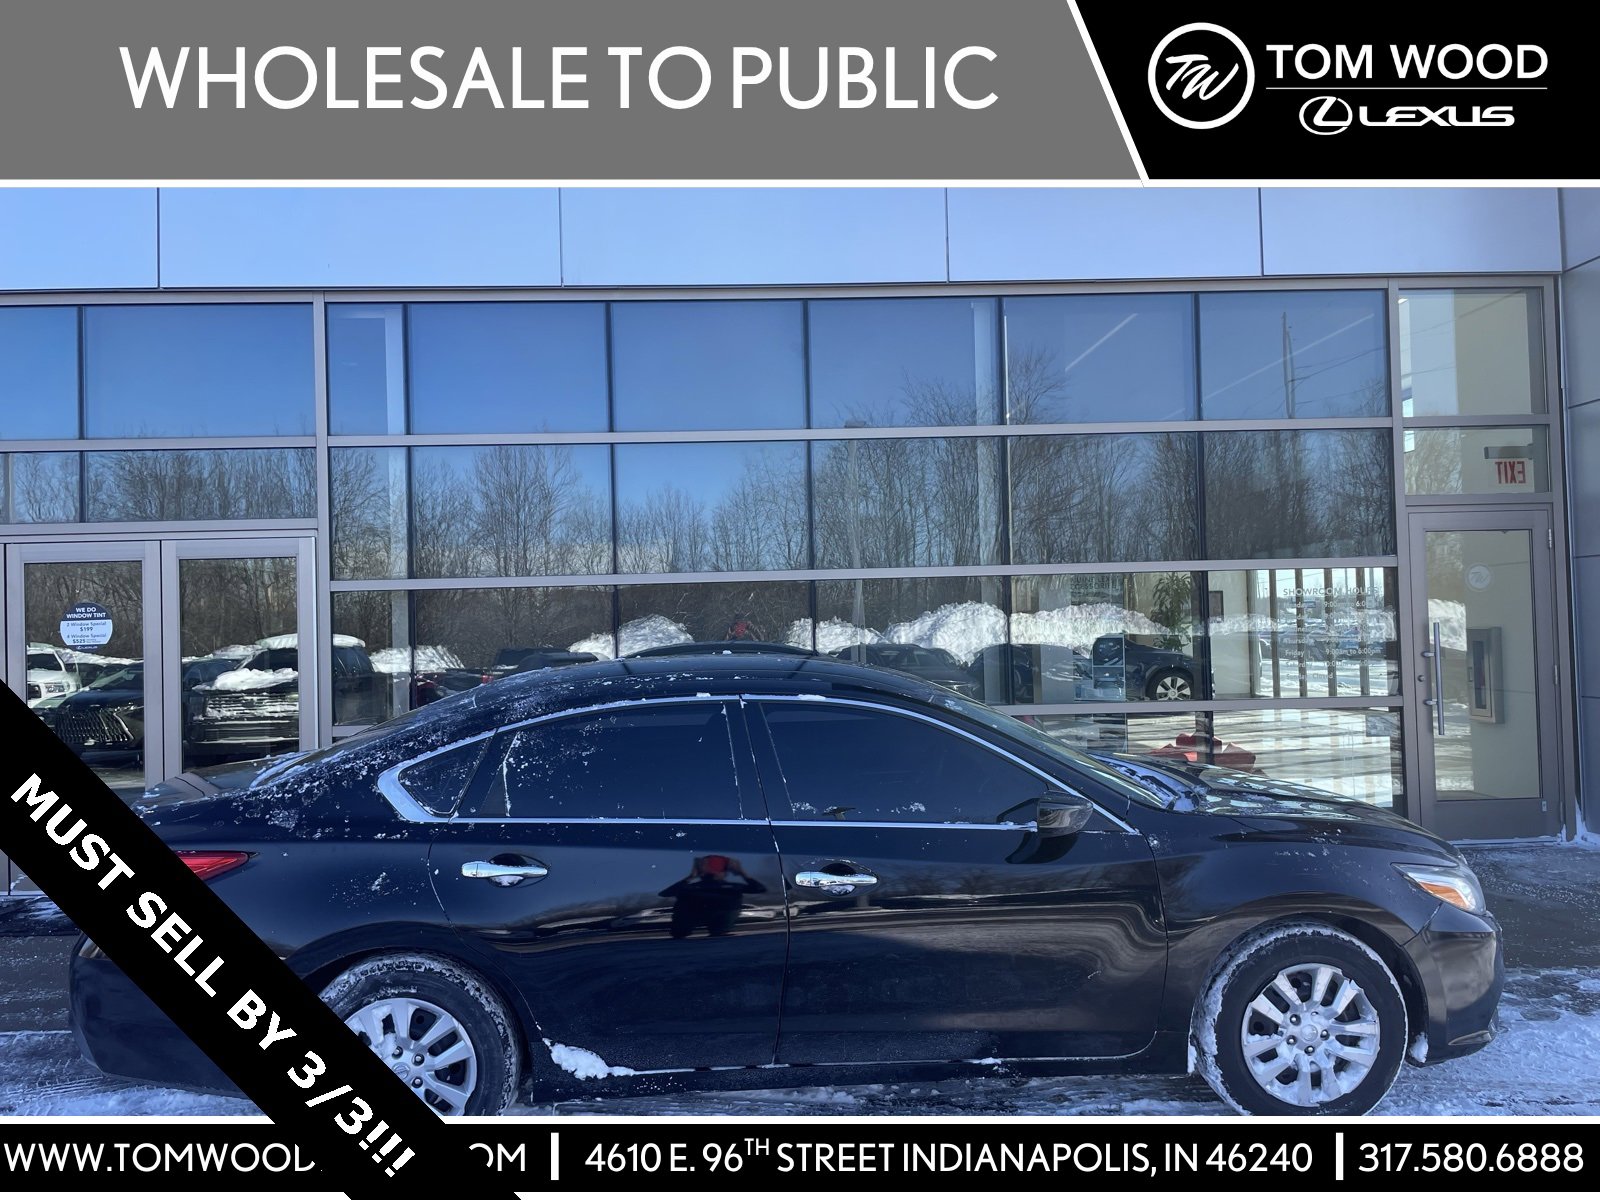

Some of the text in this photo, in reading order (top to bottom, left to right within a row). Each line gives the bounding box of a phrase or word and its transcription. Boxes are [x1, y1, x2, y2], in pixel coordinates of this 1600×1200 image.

[1283, 588, 1342, 596] SHOWROOM
[1285, 650, 1305, 658] Friday
[1357, 647, 1381, 656] 6:00pm
